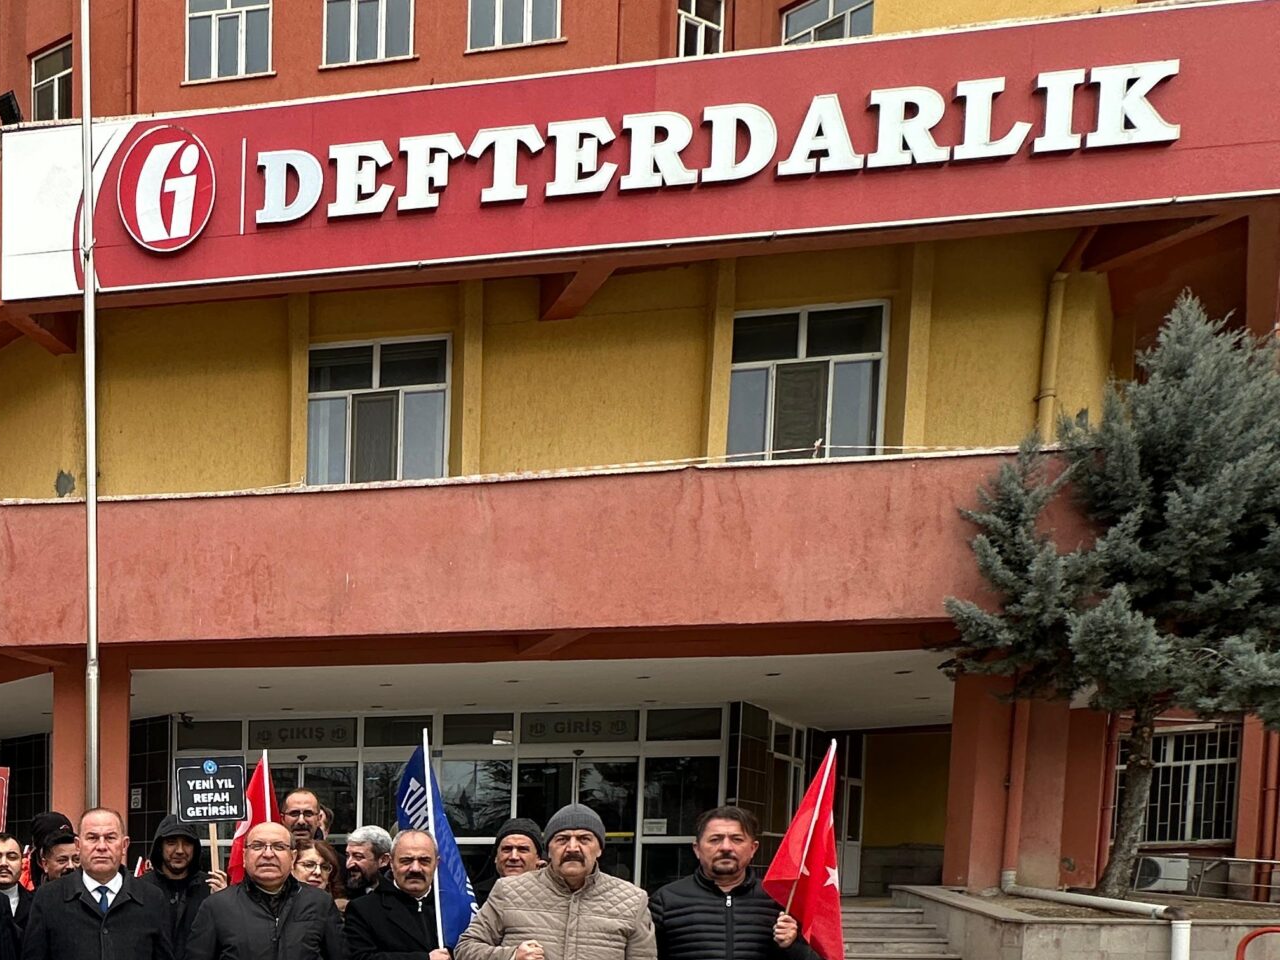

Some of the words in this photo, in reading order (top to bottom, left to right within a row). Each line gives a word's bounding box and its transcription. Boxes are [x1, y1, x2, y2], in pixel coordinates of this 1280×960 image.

[255, 58, 1182, 227] DEFTERDARLIK
[553, 717, 602, 735] GİRİŞ
[278, 727, 326, 743] ÇIKIŞ
[186, 776, 214, 790] YENİ
[216, 778, 235, 789] YIL
[193, 792, 230, 803] REFAH
[186, 802, 238, 817] GETİRSİN
